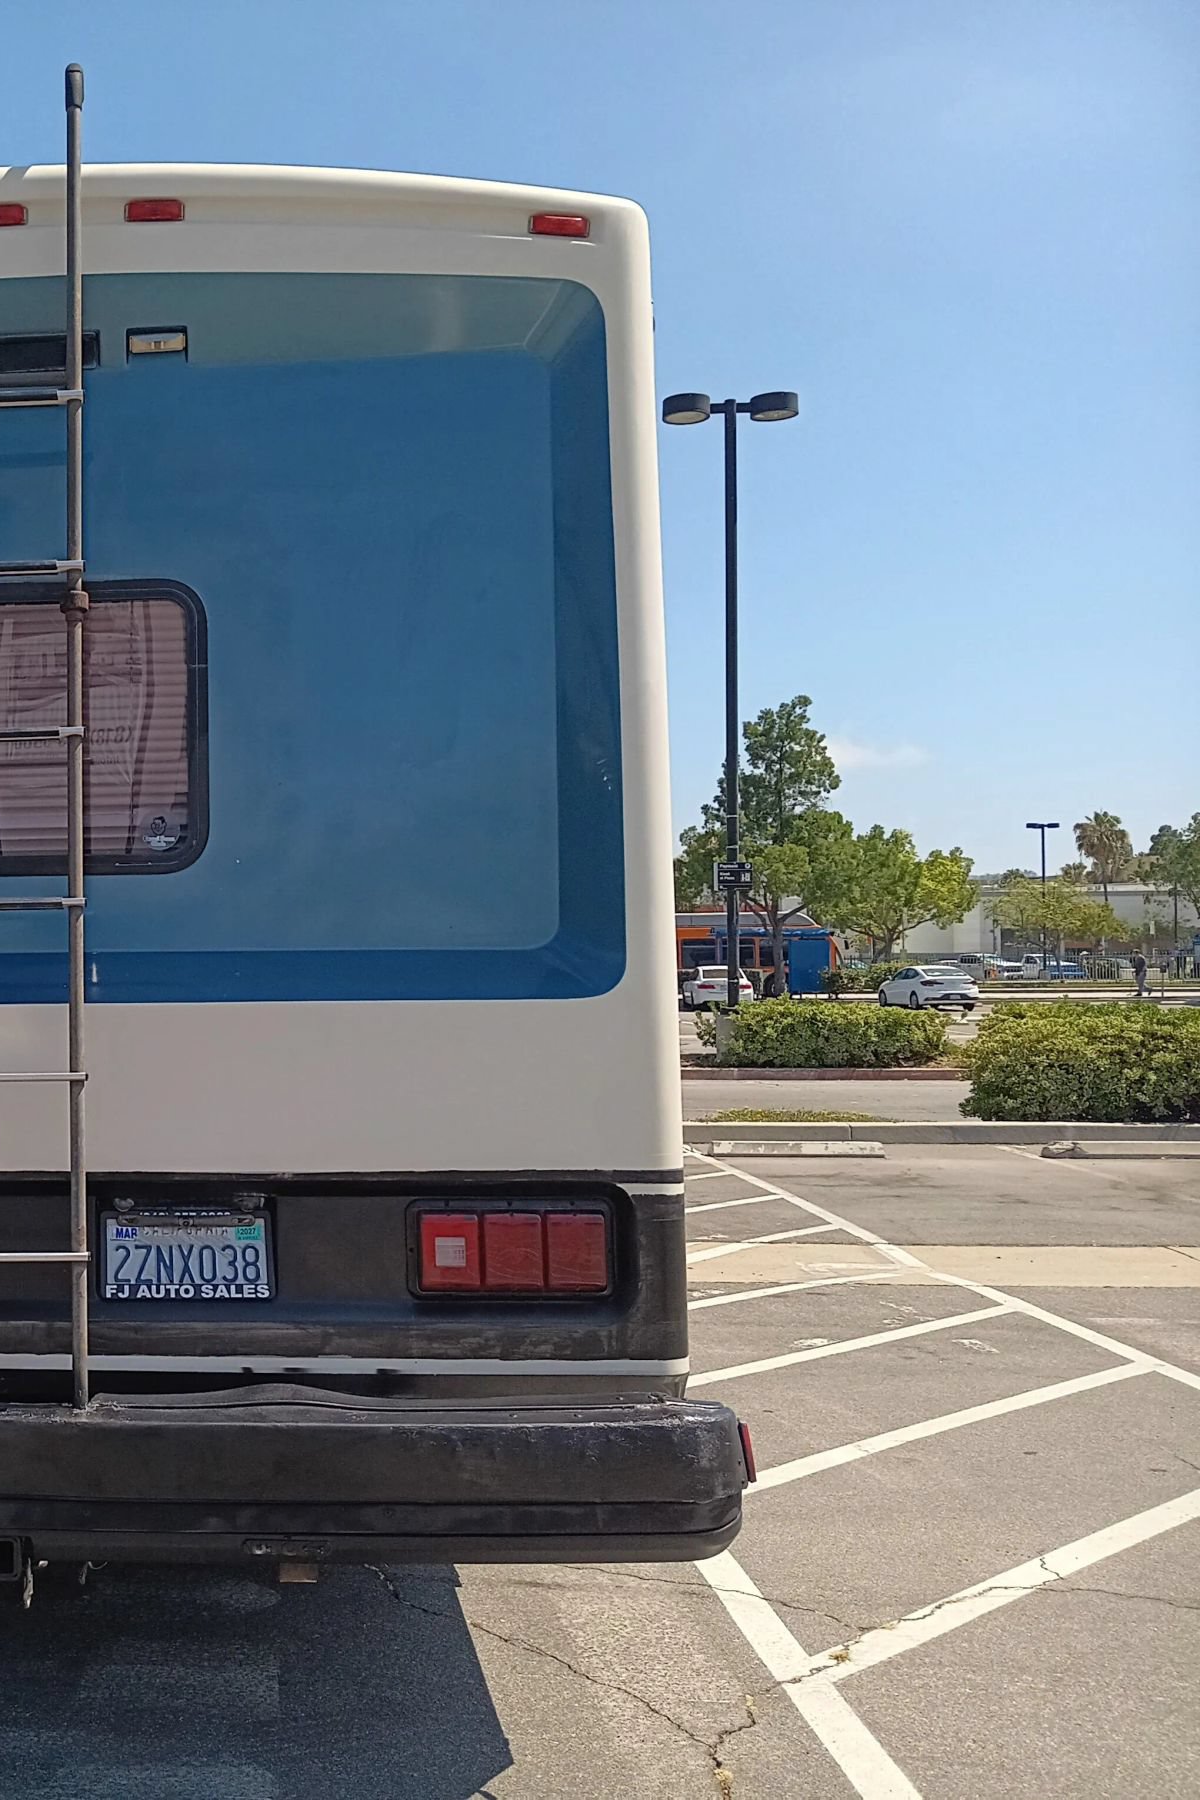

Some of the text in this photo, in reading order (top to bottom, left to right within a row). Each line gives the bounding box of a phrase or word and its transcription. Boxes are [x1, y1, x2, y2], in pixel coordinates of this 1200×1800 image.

[115, 1227, 138, 1239] MAR
[239, 1227, 256, 1235] 2027
[113, 1244, 261, 1284] 2ZNX038
[105, 1285, 270, 1298] FJ AUTO SALES
